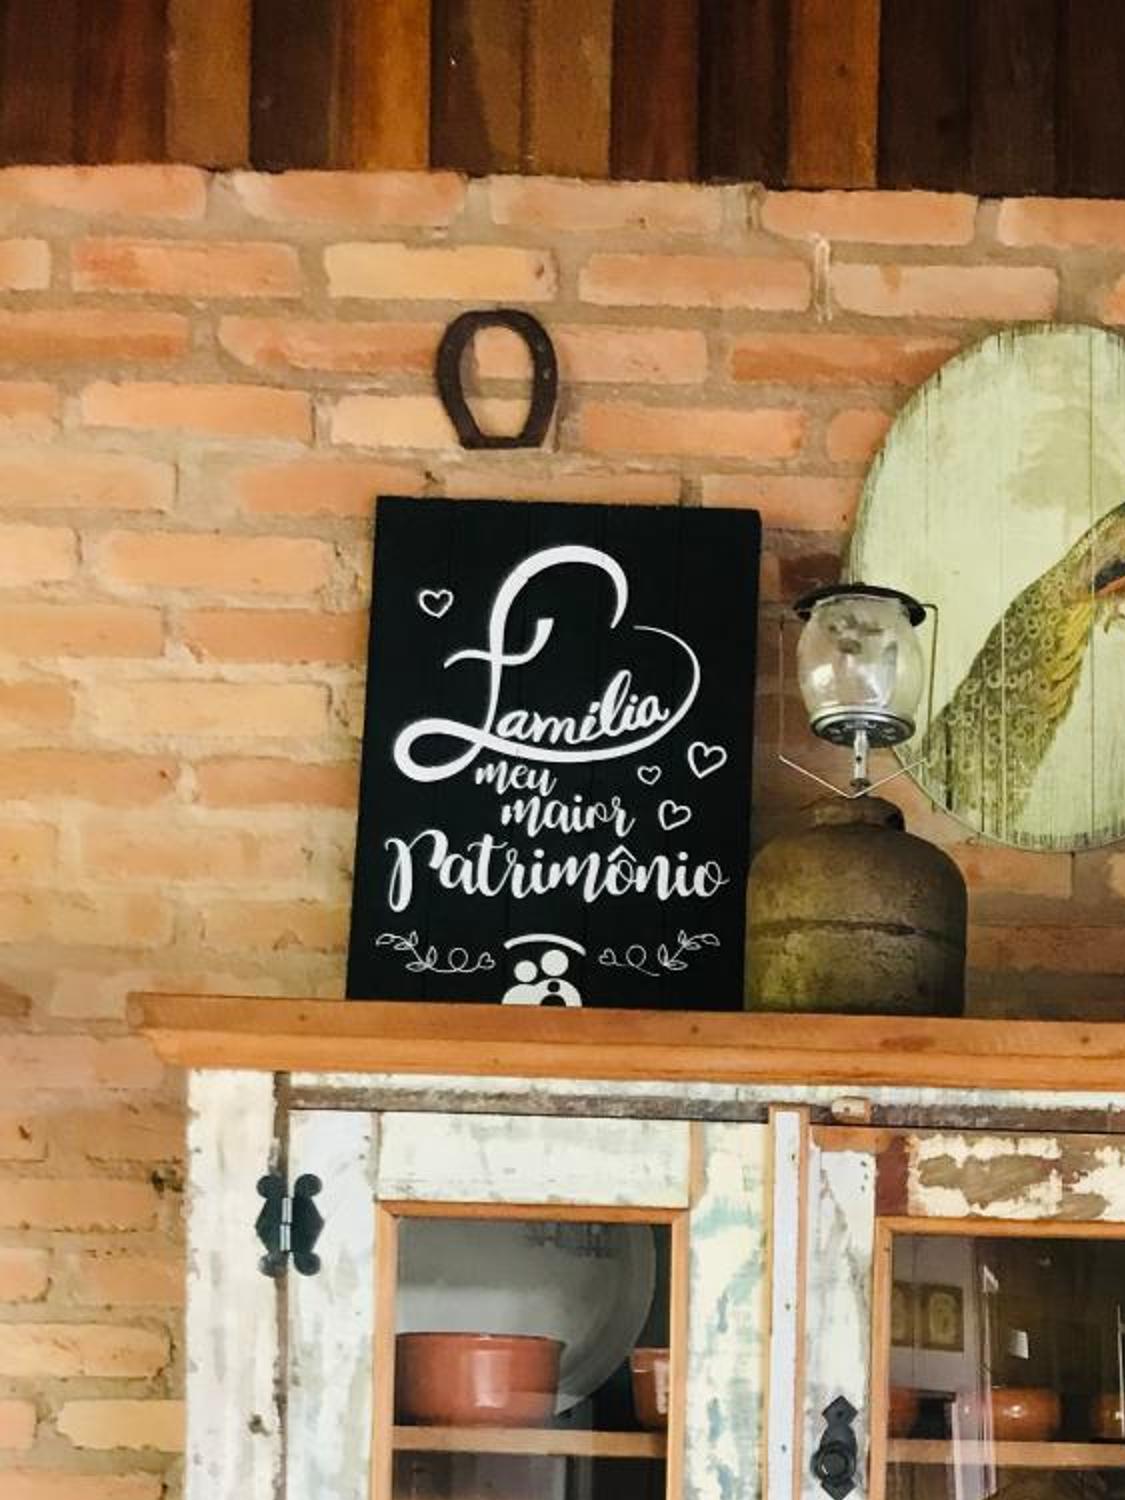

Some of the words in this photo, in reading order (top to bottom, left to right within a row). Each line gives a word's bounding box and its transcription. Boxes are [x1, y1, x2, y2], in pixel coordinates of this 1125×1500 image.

[474, 761, 557, 797] meu
[501, 795, 636, 838] maior
[385, 829, 730, 913] Patrimônio
